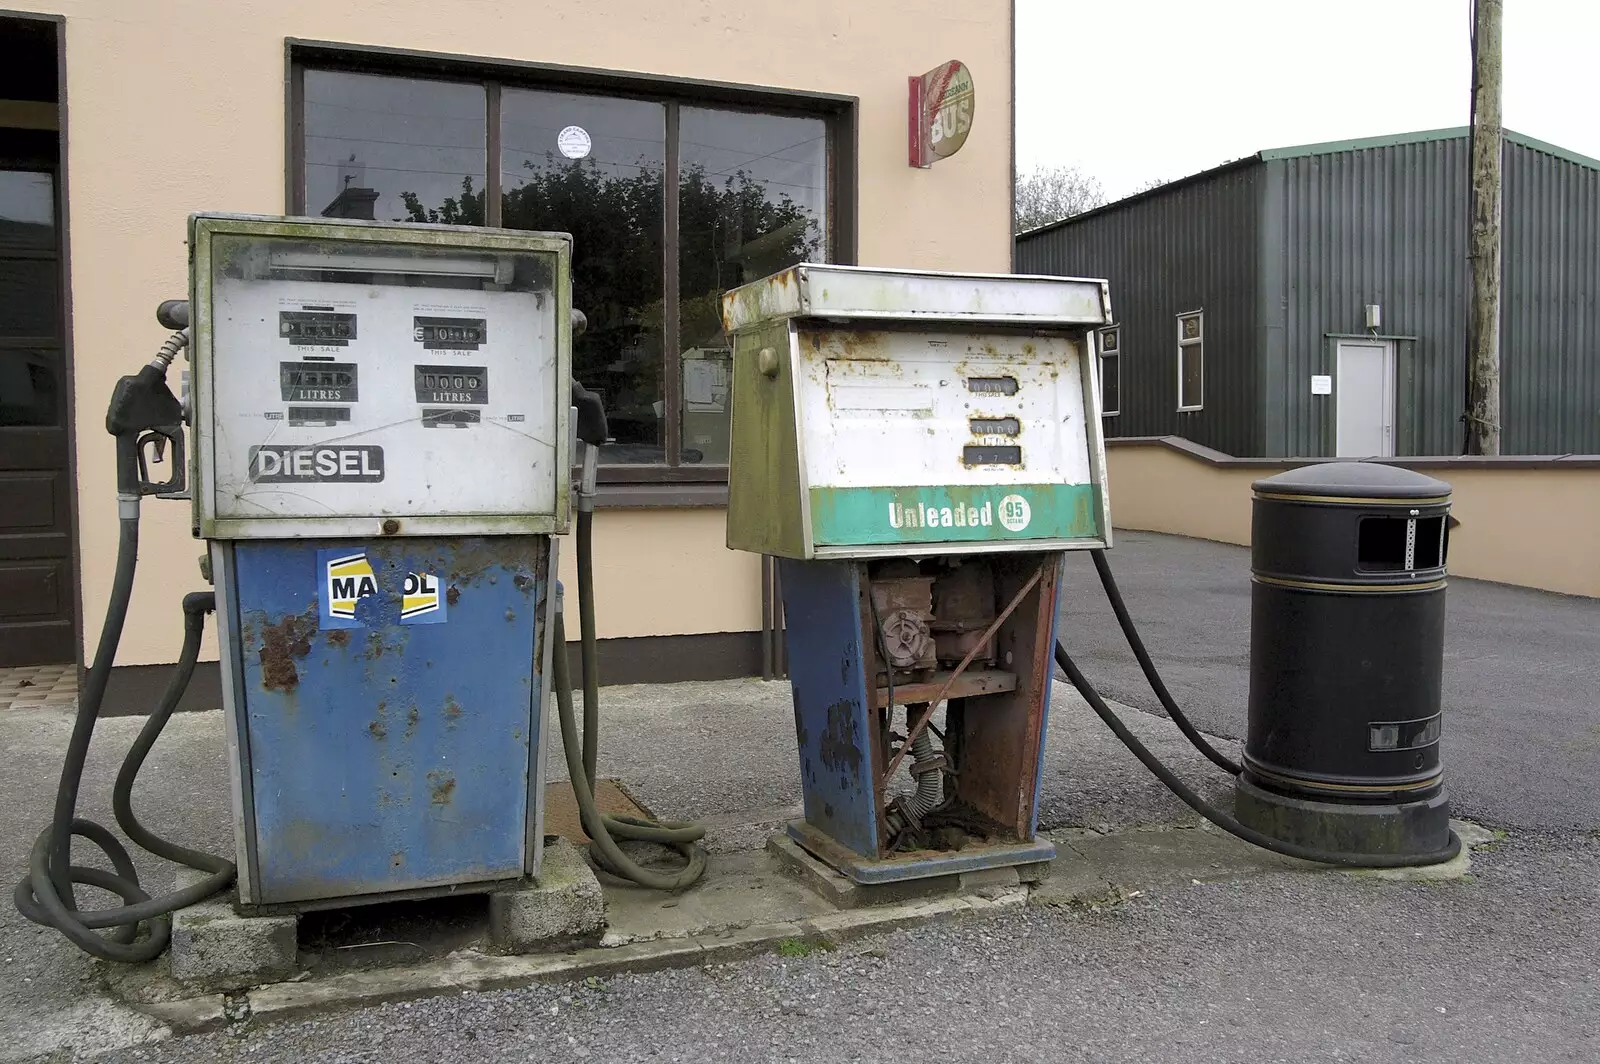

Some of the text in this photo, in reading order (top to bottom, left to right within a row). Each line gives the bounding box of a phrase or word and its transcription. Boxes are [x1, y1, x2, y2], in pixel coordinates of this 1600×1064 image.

[931, 98, 970, 144] BUS
[300, 390, 341, 399] LITRES
[433, 392, 472, 402] LITRES
[258, 449, 381, 476] DIESEL
[889, 501, 1023, 528] Unleaded 95
[332, 575, 436, 599] MAOL
